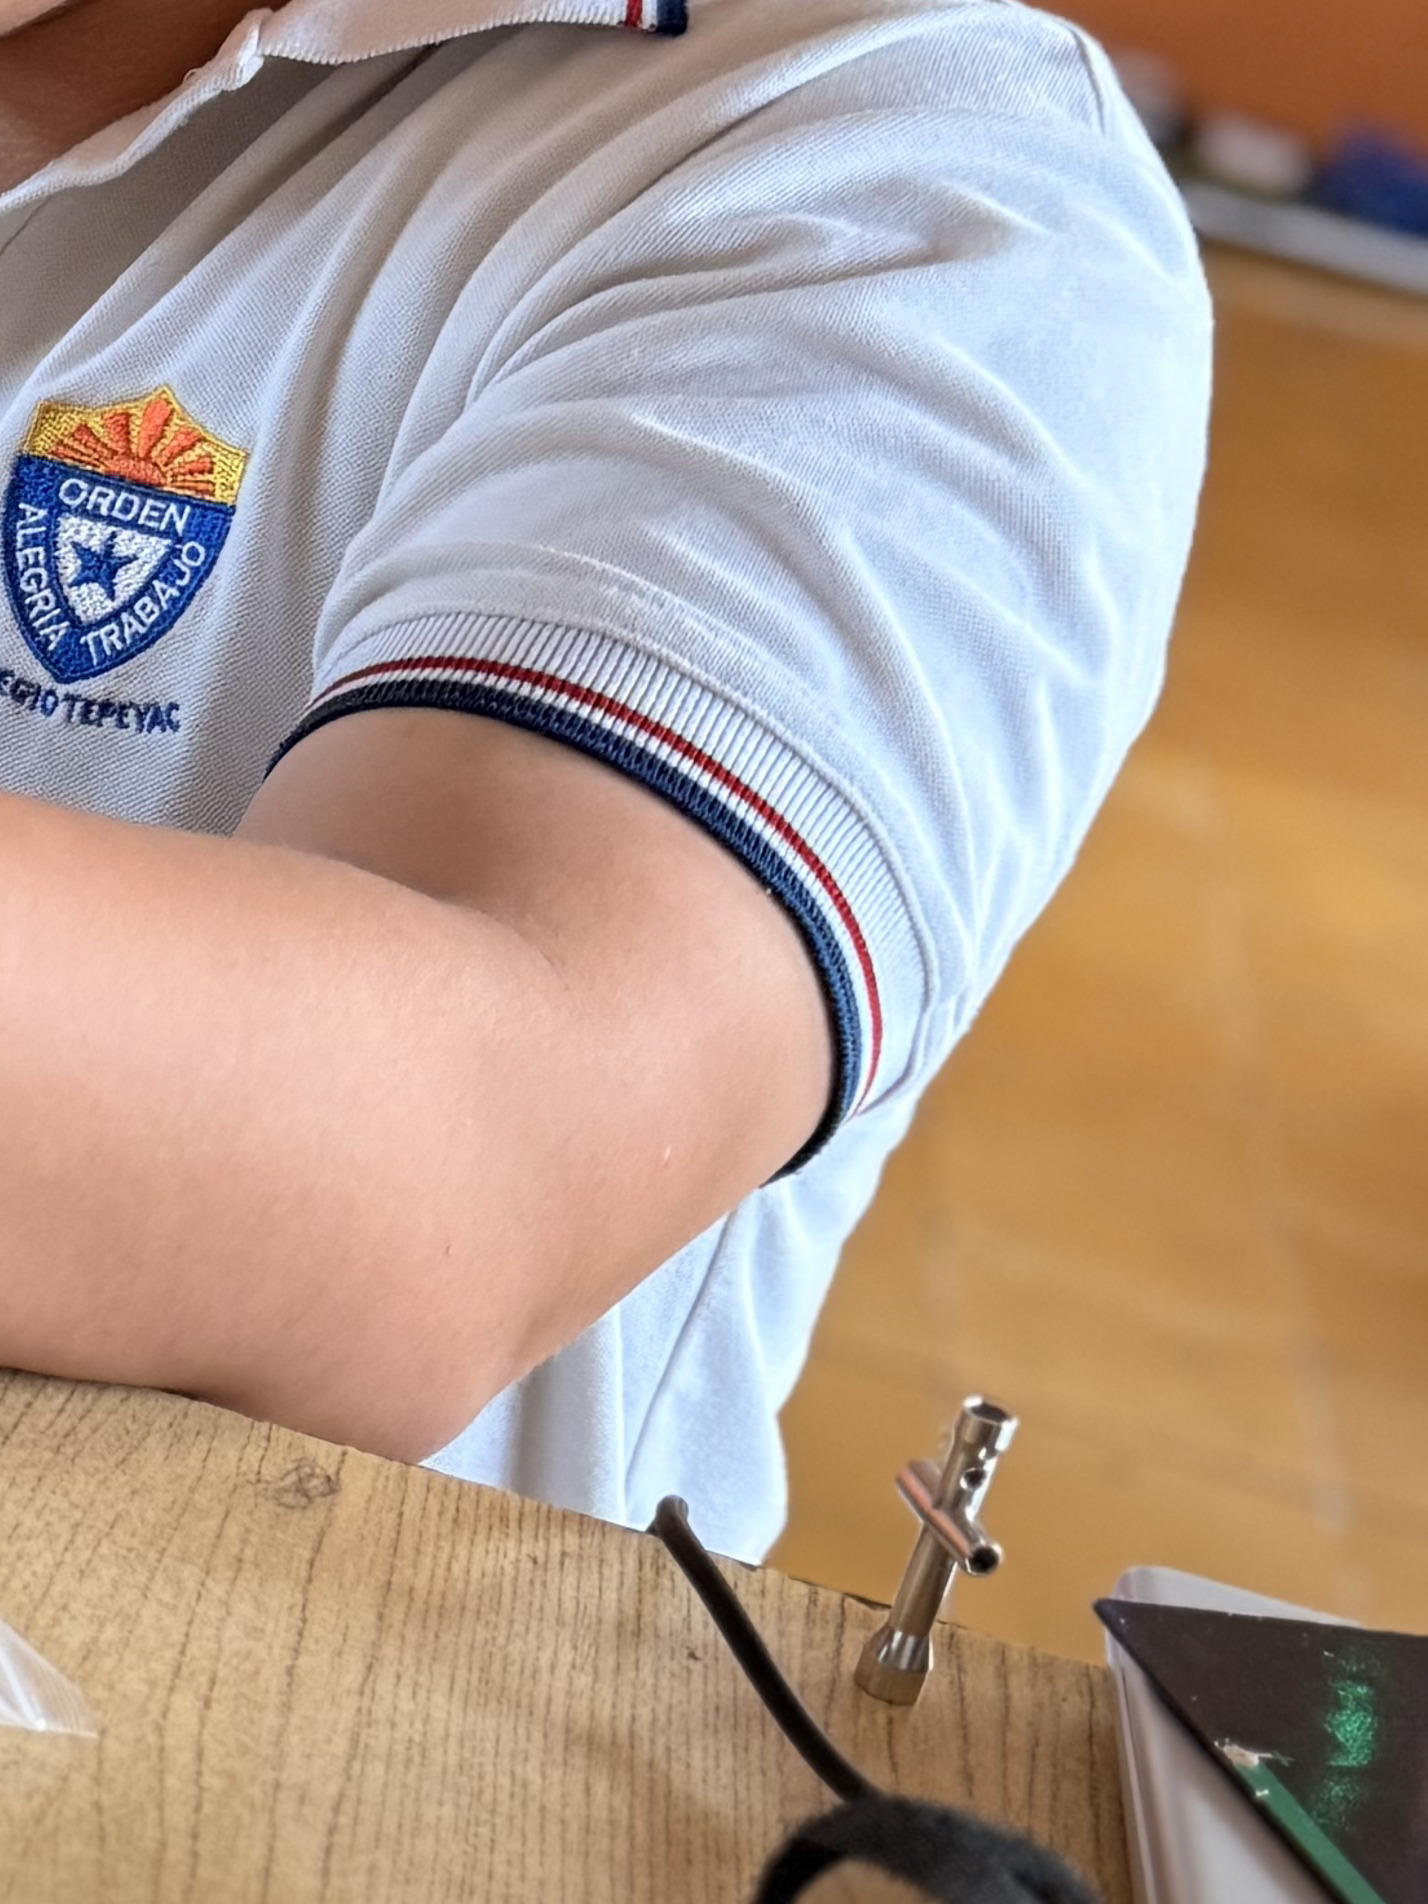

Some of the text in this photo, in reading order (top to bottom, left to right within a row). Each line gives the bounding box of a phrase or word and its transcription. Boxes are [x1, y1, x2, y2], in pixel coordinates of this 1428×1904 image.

[58, 477, 191, 537] ORDEN
[16, 502, 71, 652] ALEGRIA
[80, 540, 206, 666] TRABAJO
[61, 693, 181, 734] TEPEYAC
